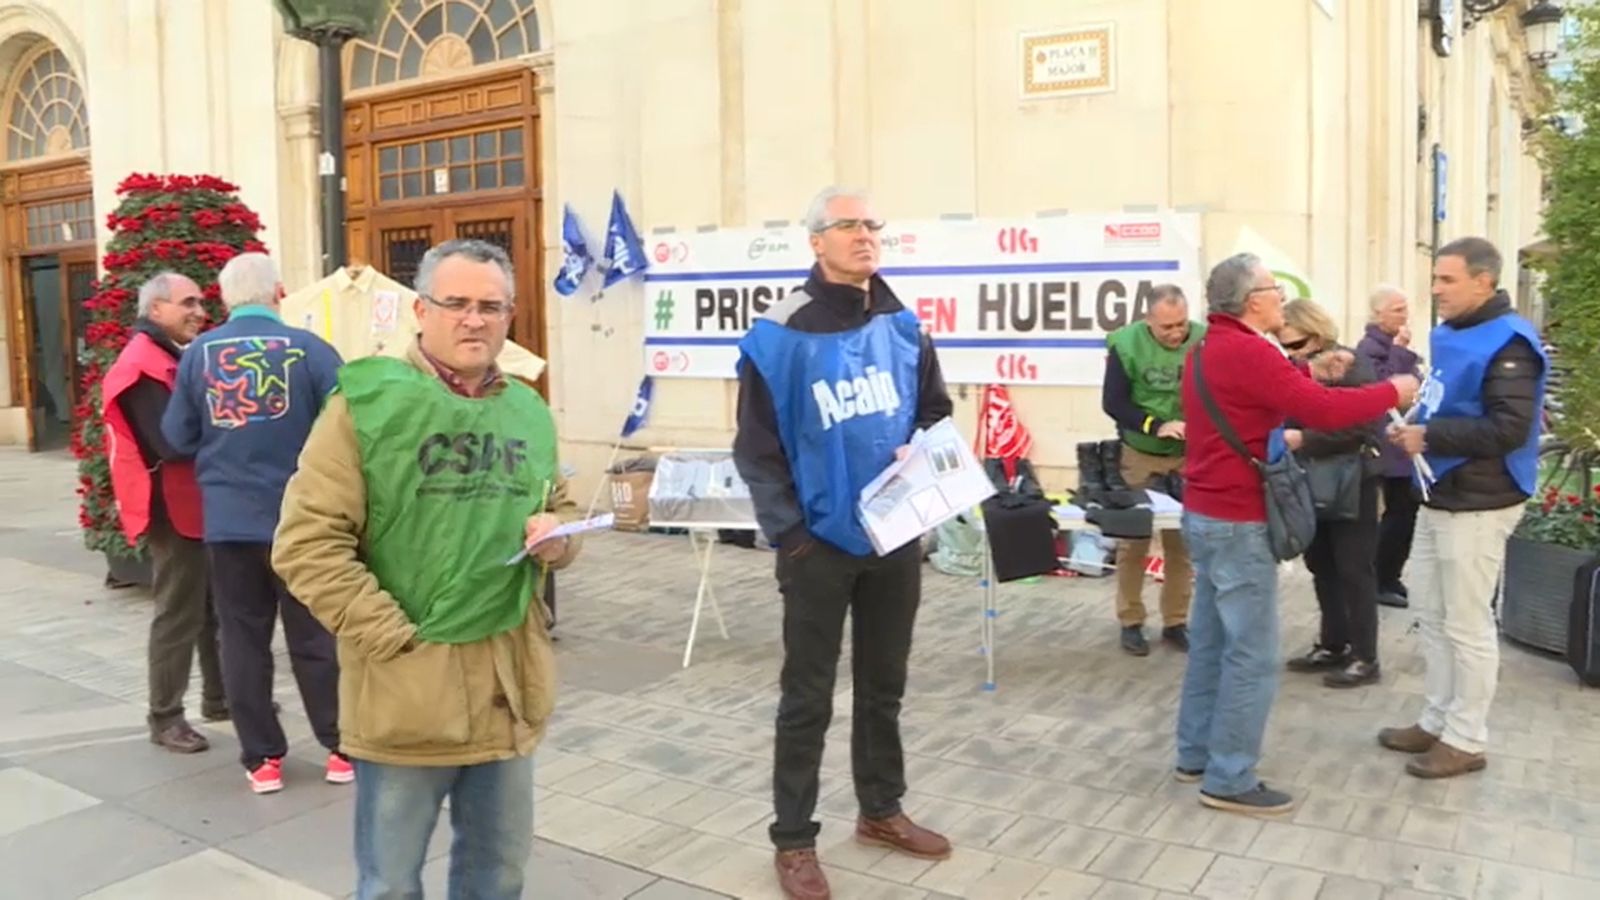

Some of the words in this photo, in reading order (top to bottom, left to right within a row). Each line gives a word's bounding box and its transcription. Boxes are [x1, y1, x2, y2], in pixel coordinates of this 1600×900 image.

[655, 290, 675, 331] #
[917, 297, 957, 333] EN
[977, 279, 1154, 332] HUELGA
[811, 365, 901, 430] Acaip
